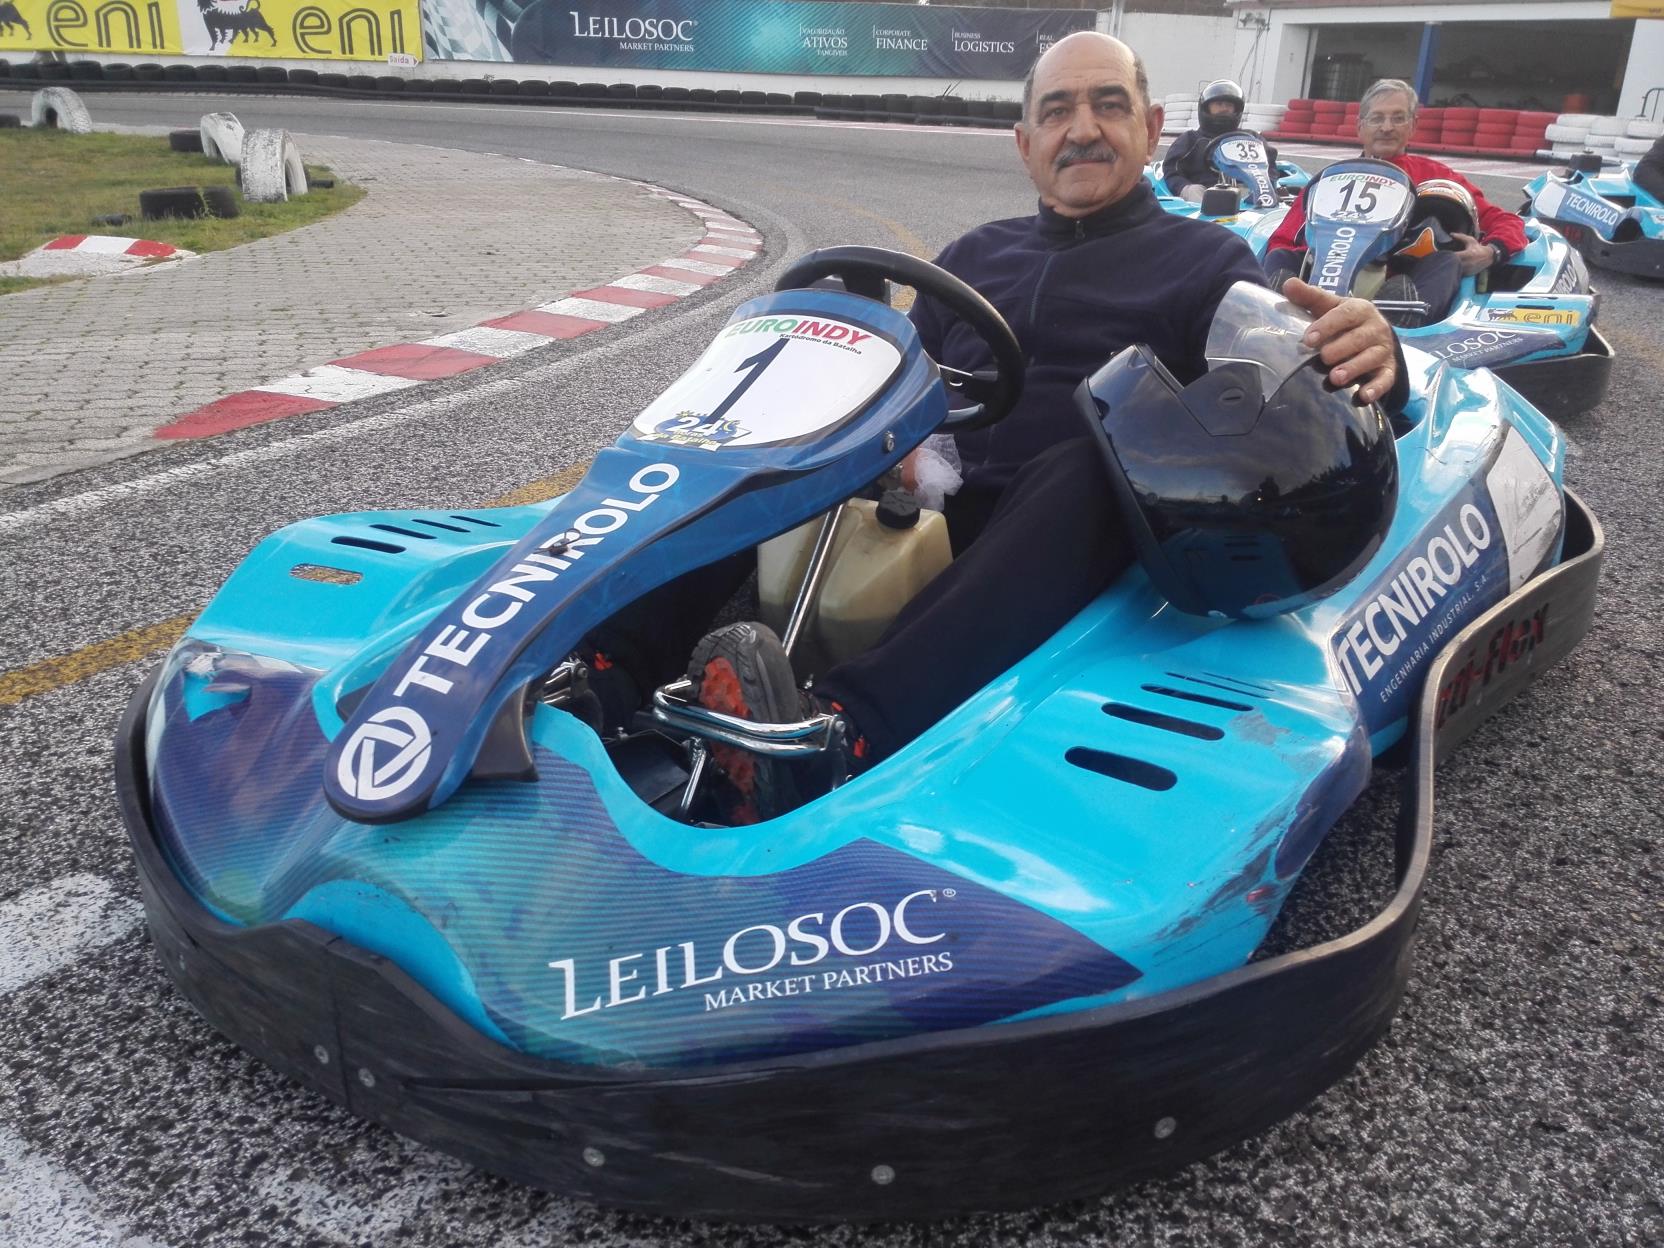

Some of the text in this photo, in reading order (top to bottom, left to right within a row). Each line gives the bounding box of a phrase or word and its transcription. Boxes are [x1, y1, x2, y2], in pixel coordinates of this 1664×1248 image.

[46, 0, 165, 50] eni
[292, 6, 404, 56] eni
[569, 11, 694, 41] LEILOSOC
[875, 29, 911, 37] CORPORATE
[619, 41, 694, 52] MARKET PARTNERS
[803, 37, 848, 49] ATIVOS
[876, 38, 928, 51] FINANCE
[954, 40, 1015, 53] LOGISTICS
[1236, 143, 1259, 159] 35
[1331, 174, 1396, 187] EUROINDY
[1339, 179, 1381, 214] 15
[1566, 192, 1619, 226] TECNIROLO
[1523, 310, 1573, 325] eni
[724, 319, 873, 345] EUROINDY
[832, 343, 863, 356] Batalha
[705, 337, 790, 425] 1
[665, 415, 725, 436] 24
[393, 462, 681, 697] TECNIROLO
[1336, 503, 1491, 697] TECNIROLO
[1379, 641, 1431, 703] ENGENHARIA
[704, 951, 955, 1012] MARKET PARTNERS
